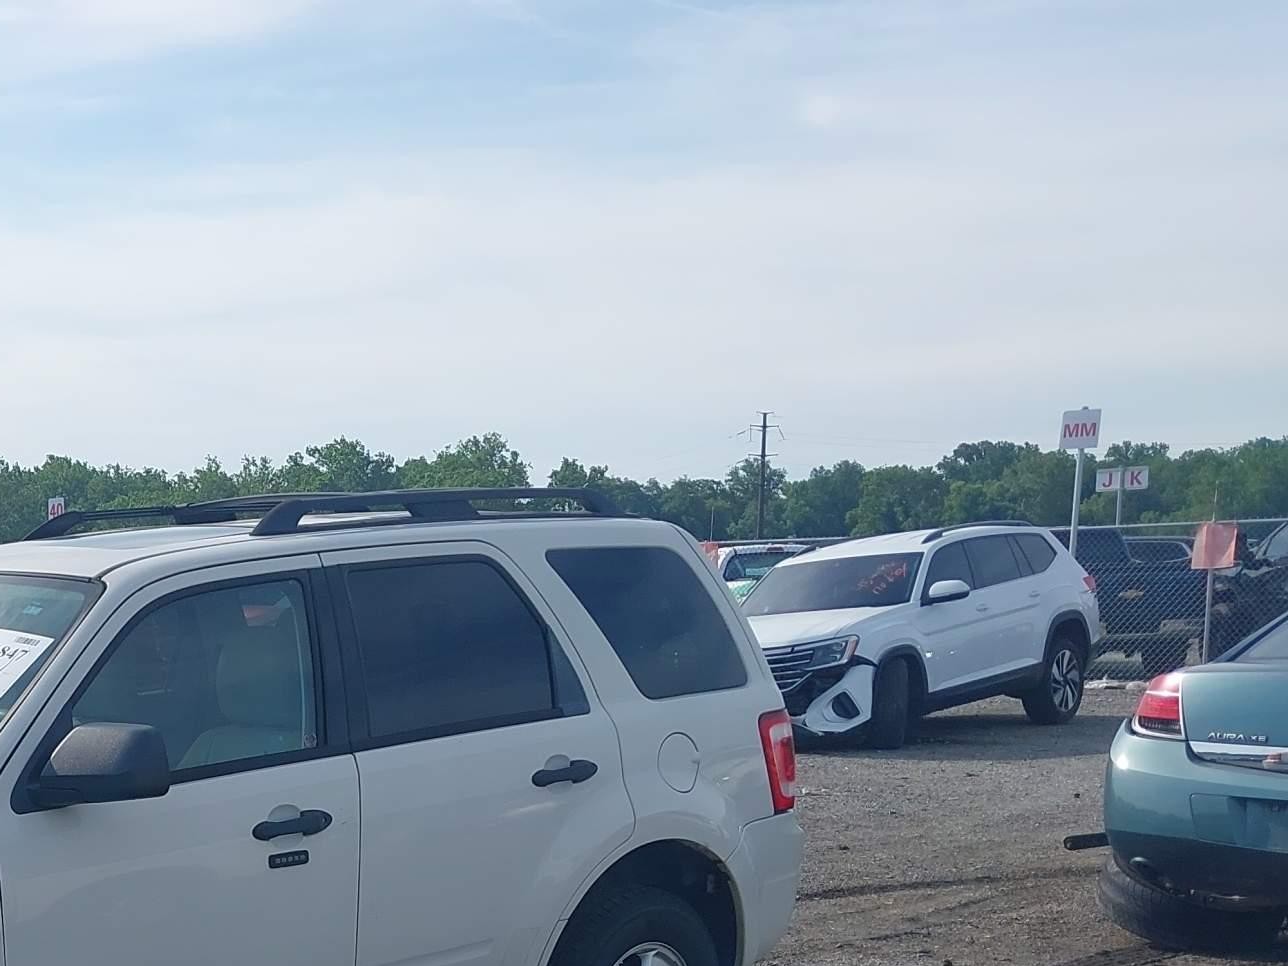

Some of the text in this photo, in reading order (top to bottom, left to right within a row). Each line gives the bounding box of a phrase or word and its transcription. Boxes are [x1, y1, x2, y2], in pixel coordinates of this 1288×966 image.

[1063, 422, 1097, 438] MM
[1102, 472, 1113, 488] J
[1130, 471, 1143, 486] K
[49, 503, 63, 518] 40
[1208, 732, 1245, 741] AURA
